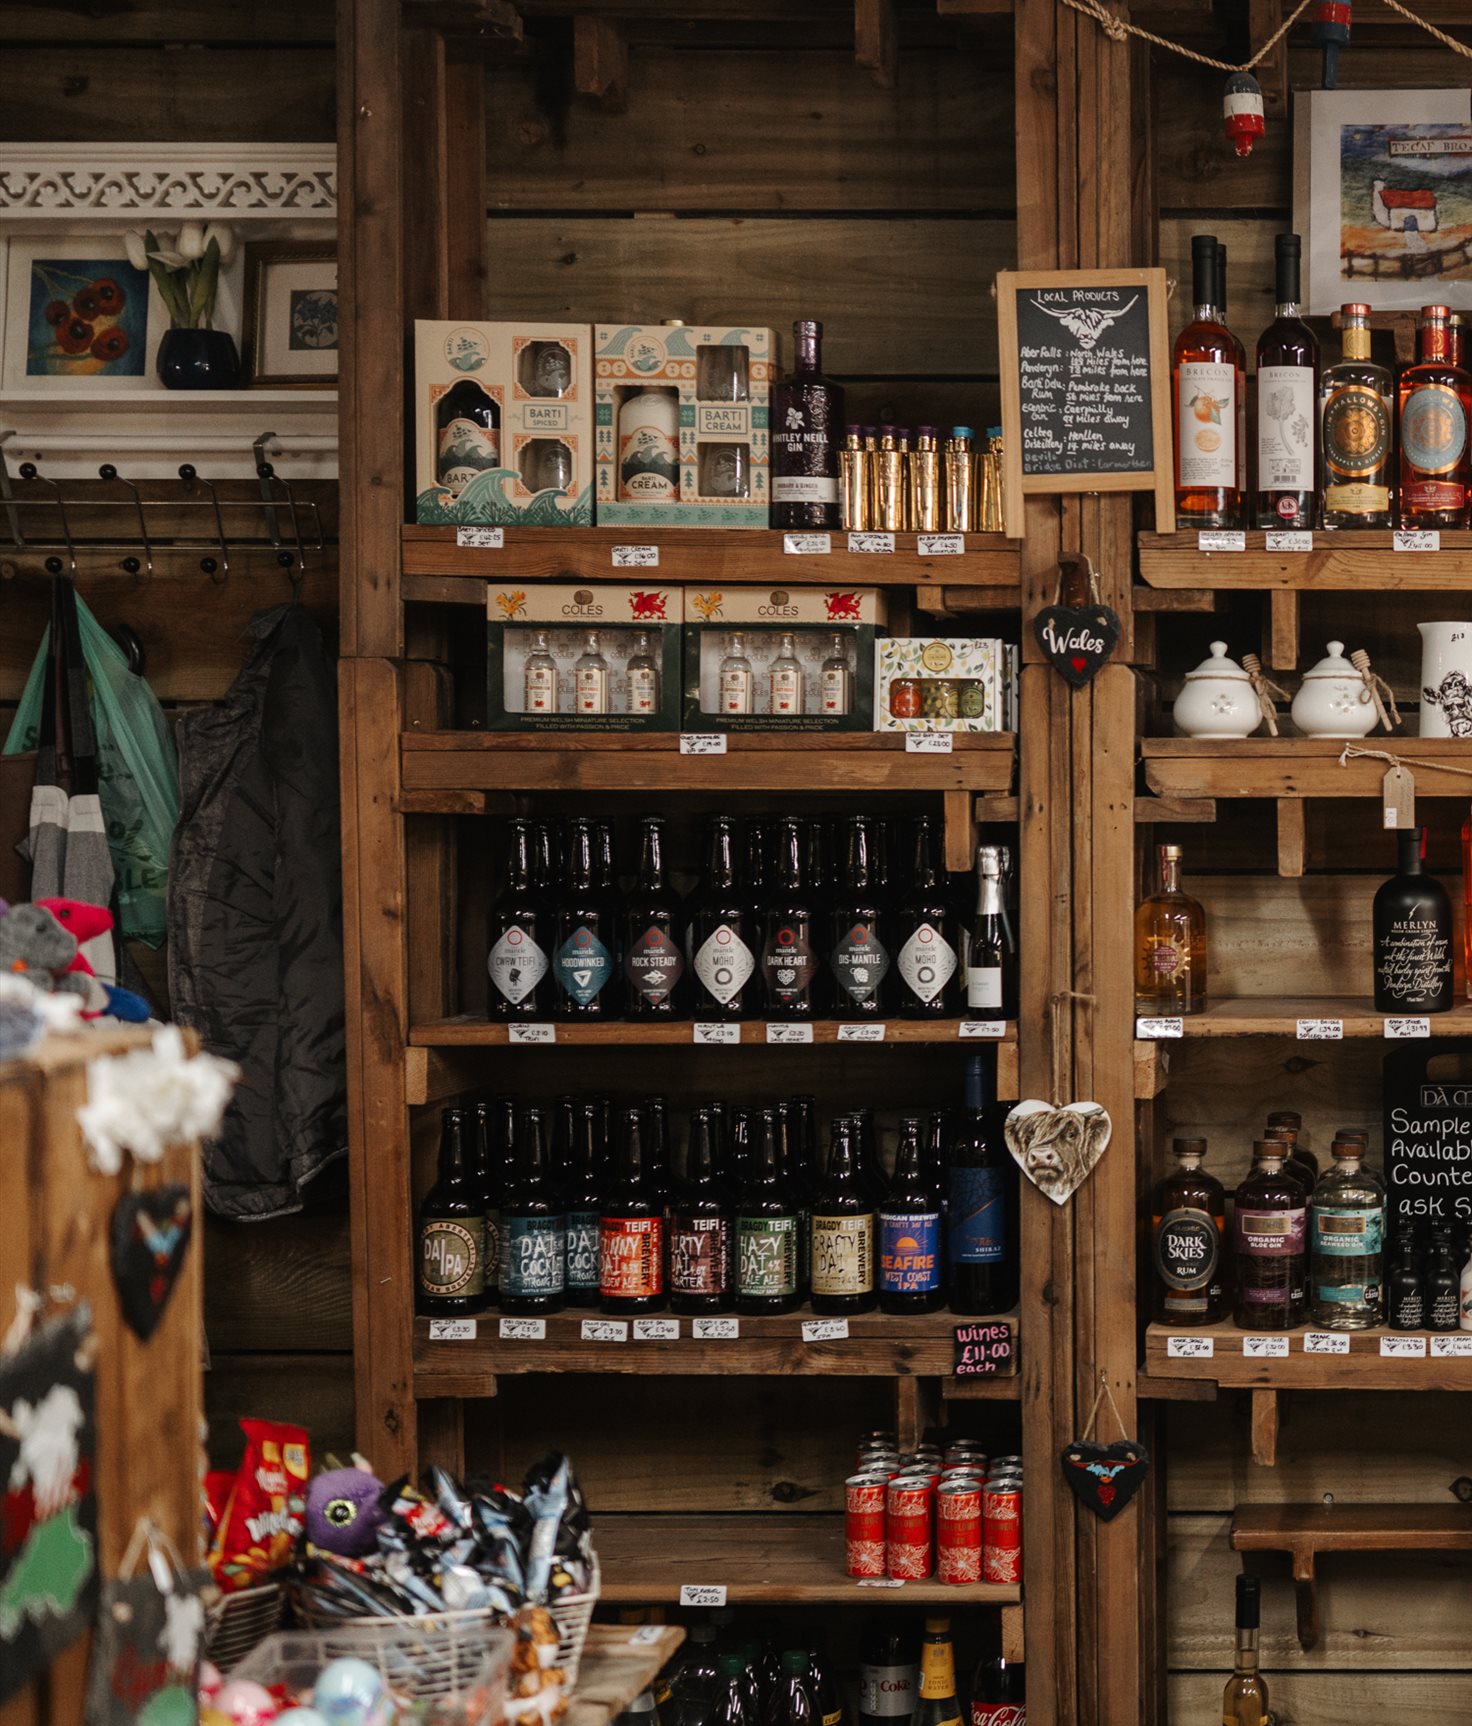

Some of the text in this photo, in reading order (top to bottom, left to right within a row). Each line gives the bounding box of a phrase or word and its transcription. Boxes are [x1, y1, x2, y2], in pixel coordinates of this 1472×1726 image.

[1392, 141, 1434, 152] TECAF
[1073, 290, 1120, 302] PRODUCTS
[1186, 368, 1228, 376] BRECON
[1334, 396, 1379, 413] HALLOWS
[530, 409, 561, 419] BARTI
[705, 411, 742, 421] BARTI
[706, 422, 741, 431] CREAM
[803, 433, 829, 443] NEILL
[787, 443, 803, 452] GIN
[632, 481, 668, 490] CREAM
[562, 605, 603, 615] COLES
[758, 606, 799, 615] COLES
[1042, 627, 1106, 654] Wales
[1394, 921, 1437, 929] MERLYN
[561, 957, 605, 968] HOODWINKED
[632, 957, 677, 967] ROCK STEADY
[712, 957, 734, 966] MOHO
[767, 956, 807, 966] DARK HEART
[838, 954, 880, 965] DIS-MANTLE
[915, 955, 936, 964] MOHO
[1399, 1196, 1445, 1217] ask
[625, 1221, 651, 1232] TEIFI
[693, 1219, 721, 1231] TEIFI
[741, 1220, 792, 1231] BRAGDY TEIFI
[815, 1220, 865, 1231] BRAGDY TEIFI
[740, 1235, 782, 1253] HAZY
[815, 1233, 857, 1252] CRAFTY
[1167, 1235, 1206, 1249] DARK
[1323, 1235, 1359, 1243] ORGANIC
[521, 1237, 557, 1256] DAI
[783, 1231, 791, 1286] BREWERY
[857, 1231, 866, 1286] BREWERY
[1168, 1246, 1204, 1260] SKIES
[642, 1233, 651, 1288] BREWERY
[740, 1254, 767, 1275] DAI
[820, 1253, 846, 1275] DAI
[881, 1254, 935, 1270] SEAFIRE
[1176, 1267, 1197, 1275] RUM
[741, 1274, 780, 1285] PALE ALE
[884, 1271, 930, 1283] WEST COAST
[898, 1281, 918, 1290] IPA
[957, 1323, 1009, 1344] Wines
[956, 1363, 996, 1375] each
[880, 1679, 911, 1694] Coke
